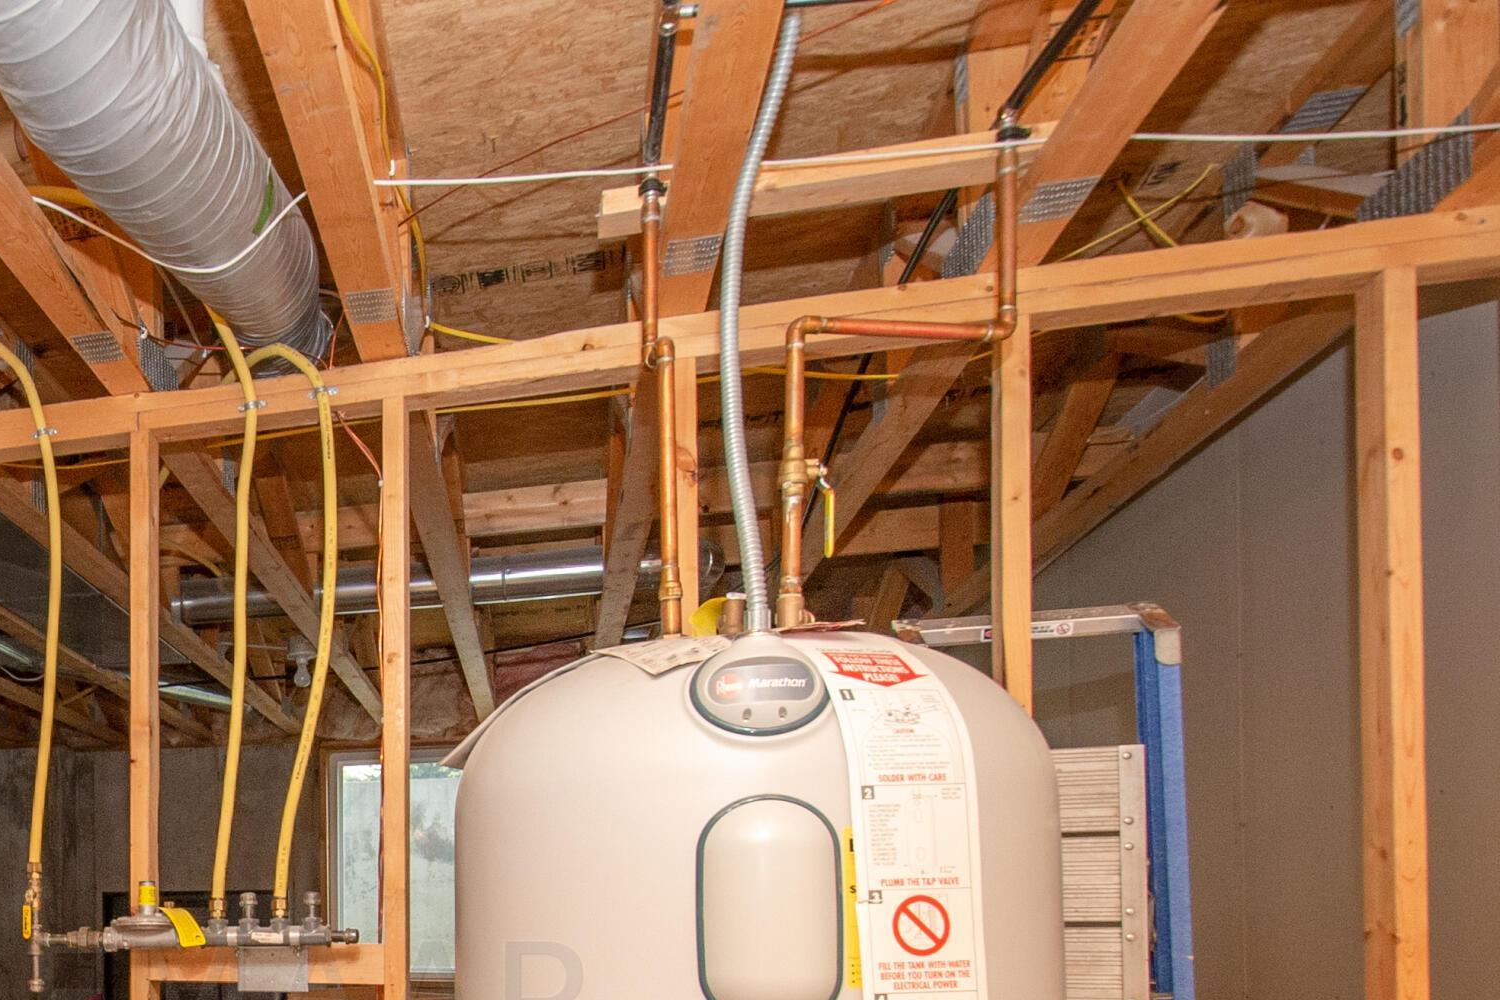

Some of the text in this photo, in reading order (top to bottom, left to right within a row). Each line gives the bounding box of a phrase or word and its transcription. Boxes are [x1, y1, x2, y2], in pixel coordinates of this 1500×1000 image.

[748, 677, 807, 689] Marathon
[878, 773, 947, 783] SOLDER WITH CARE
[880, 878, 905, 887] PLUMB
[908, 878, 920, 886] THE
[938, 877, 960, 885] VALVE
[893, 961, 905, 970] THE
[908, 960, 924, 969] TANK
[928, 960, 946, 969] WITH
[880, 972, 905, 981] BEFORE
[908, 971, 922, 980] YOU
[924, 971, 942, 979] TURN
[958, 970, 971, 978] THE
[933, 980, 958, 989] POWER
